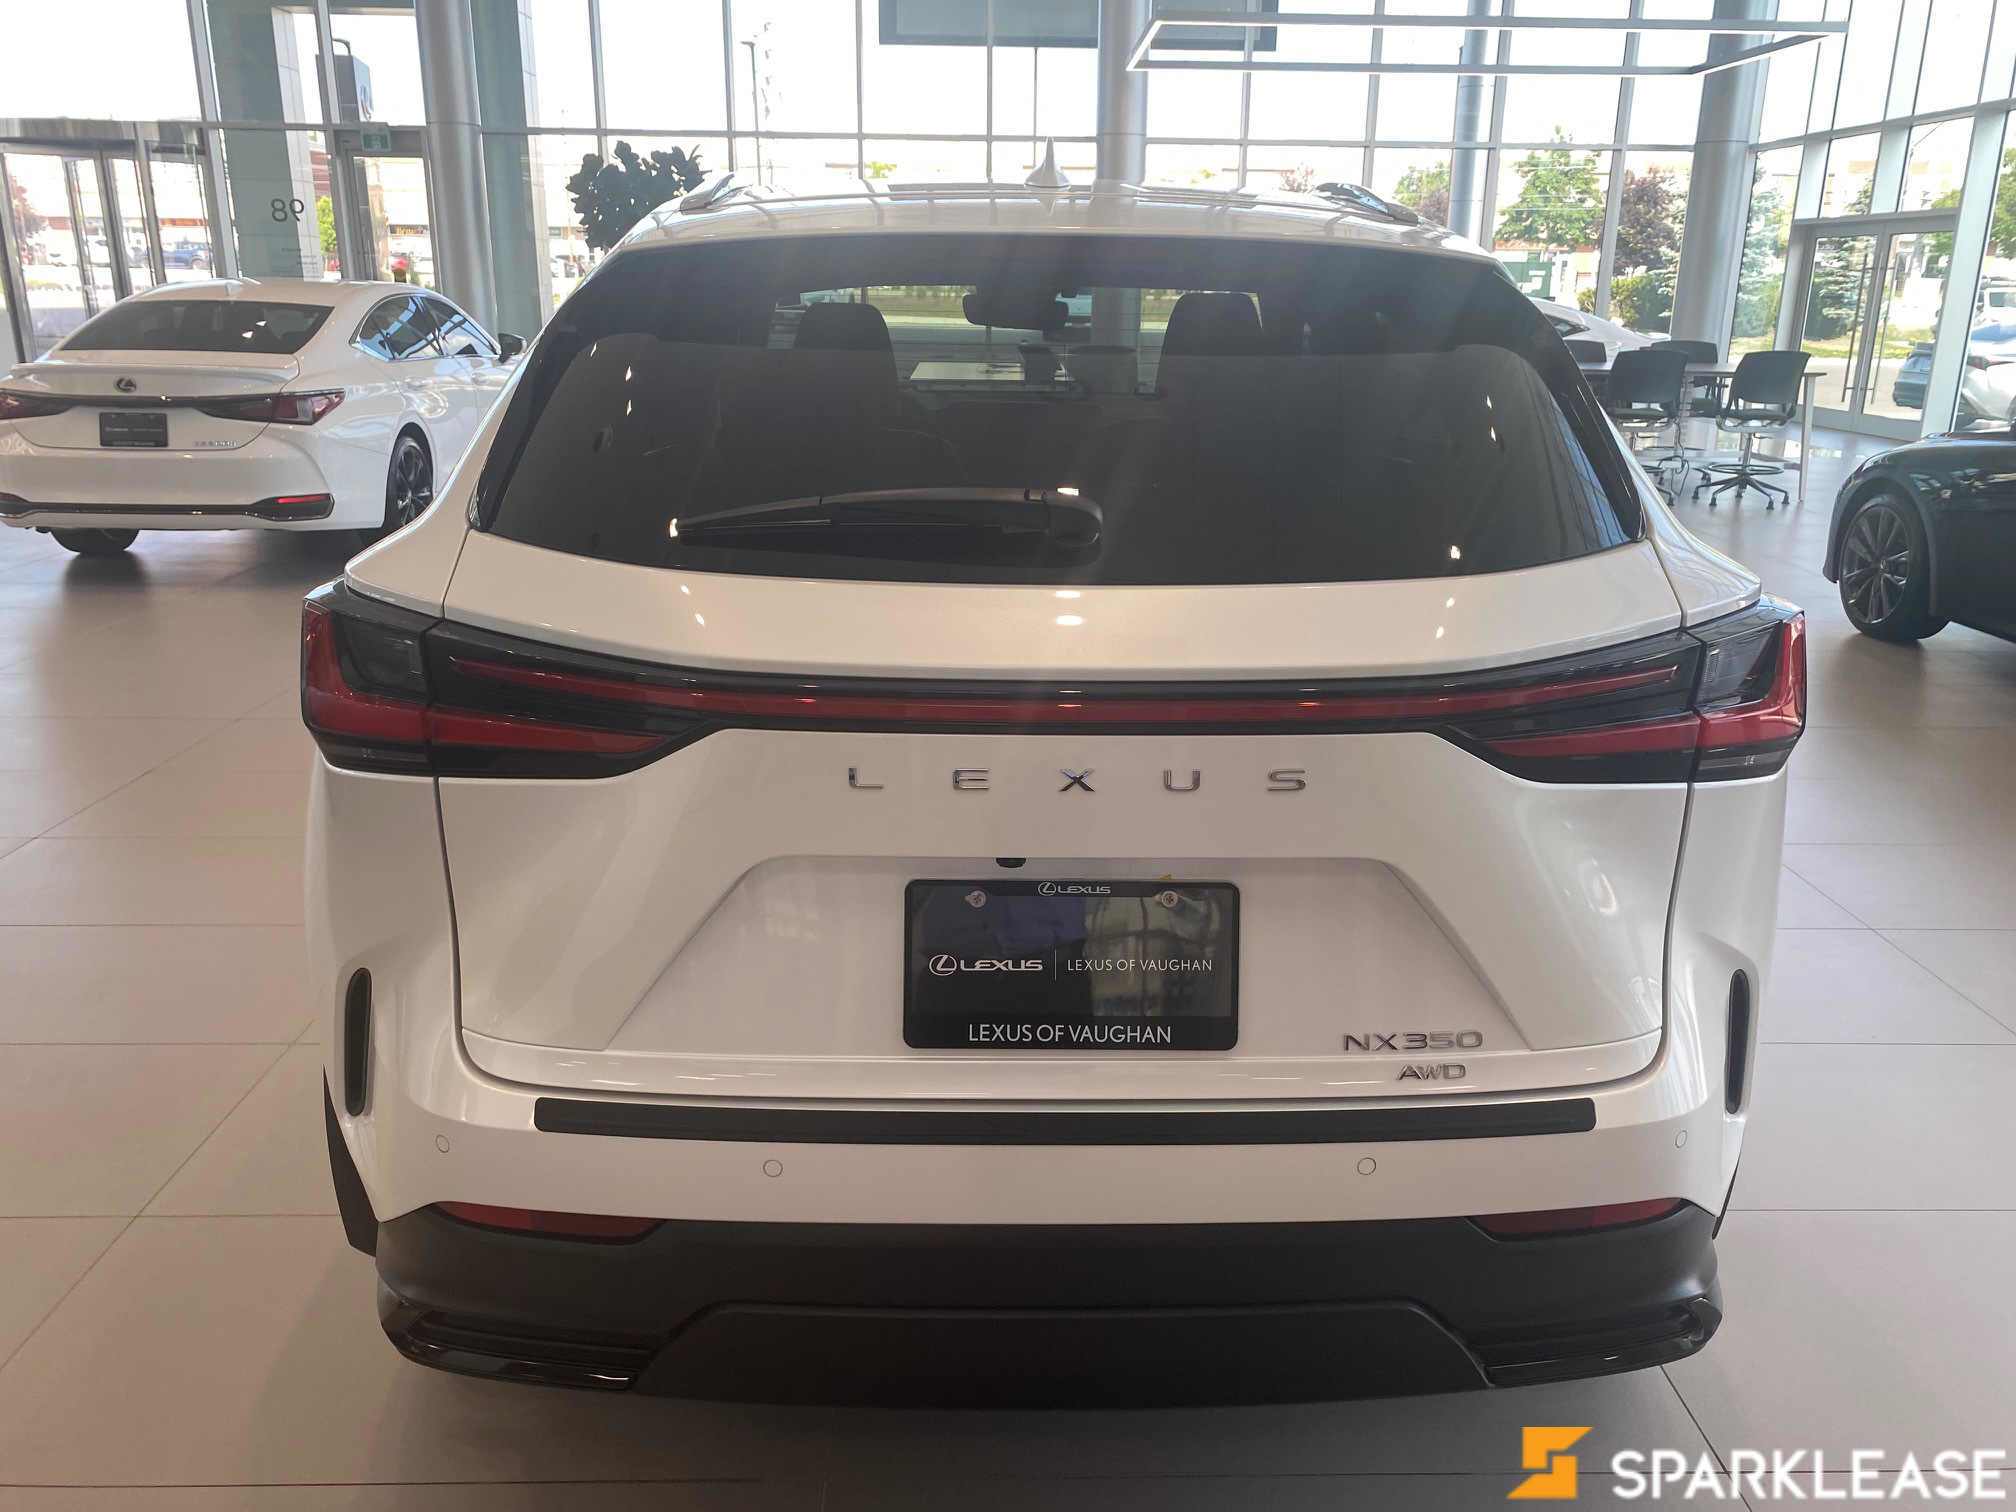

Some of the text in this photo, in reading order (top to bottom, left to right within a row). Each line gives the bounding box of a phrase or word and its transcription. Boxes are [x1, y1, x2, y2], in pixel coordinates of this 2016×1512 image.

[848, 767, 1307, 793] LEXUS
[1056, 885, 1111, 894] LEXUS
[959, 960, 1044, 971] LEXUS
[1067, 959, 1212, 971] LEXUS OF VAUGHAN
[968, 1024, 1172, 1043] LEXUS OF VAUGHAN
[1343, 1031, 1484, 1051] NX350
[1398, 1064, 1467, 1081] AWD
